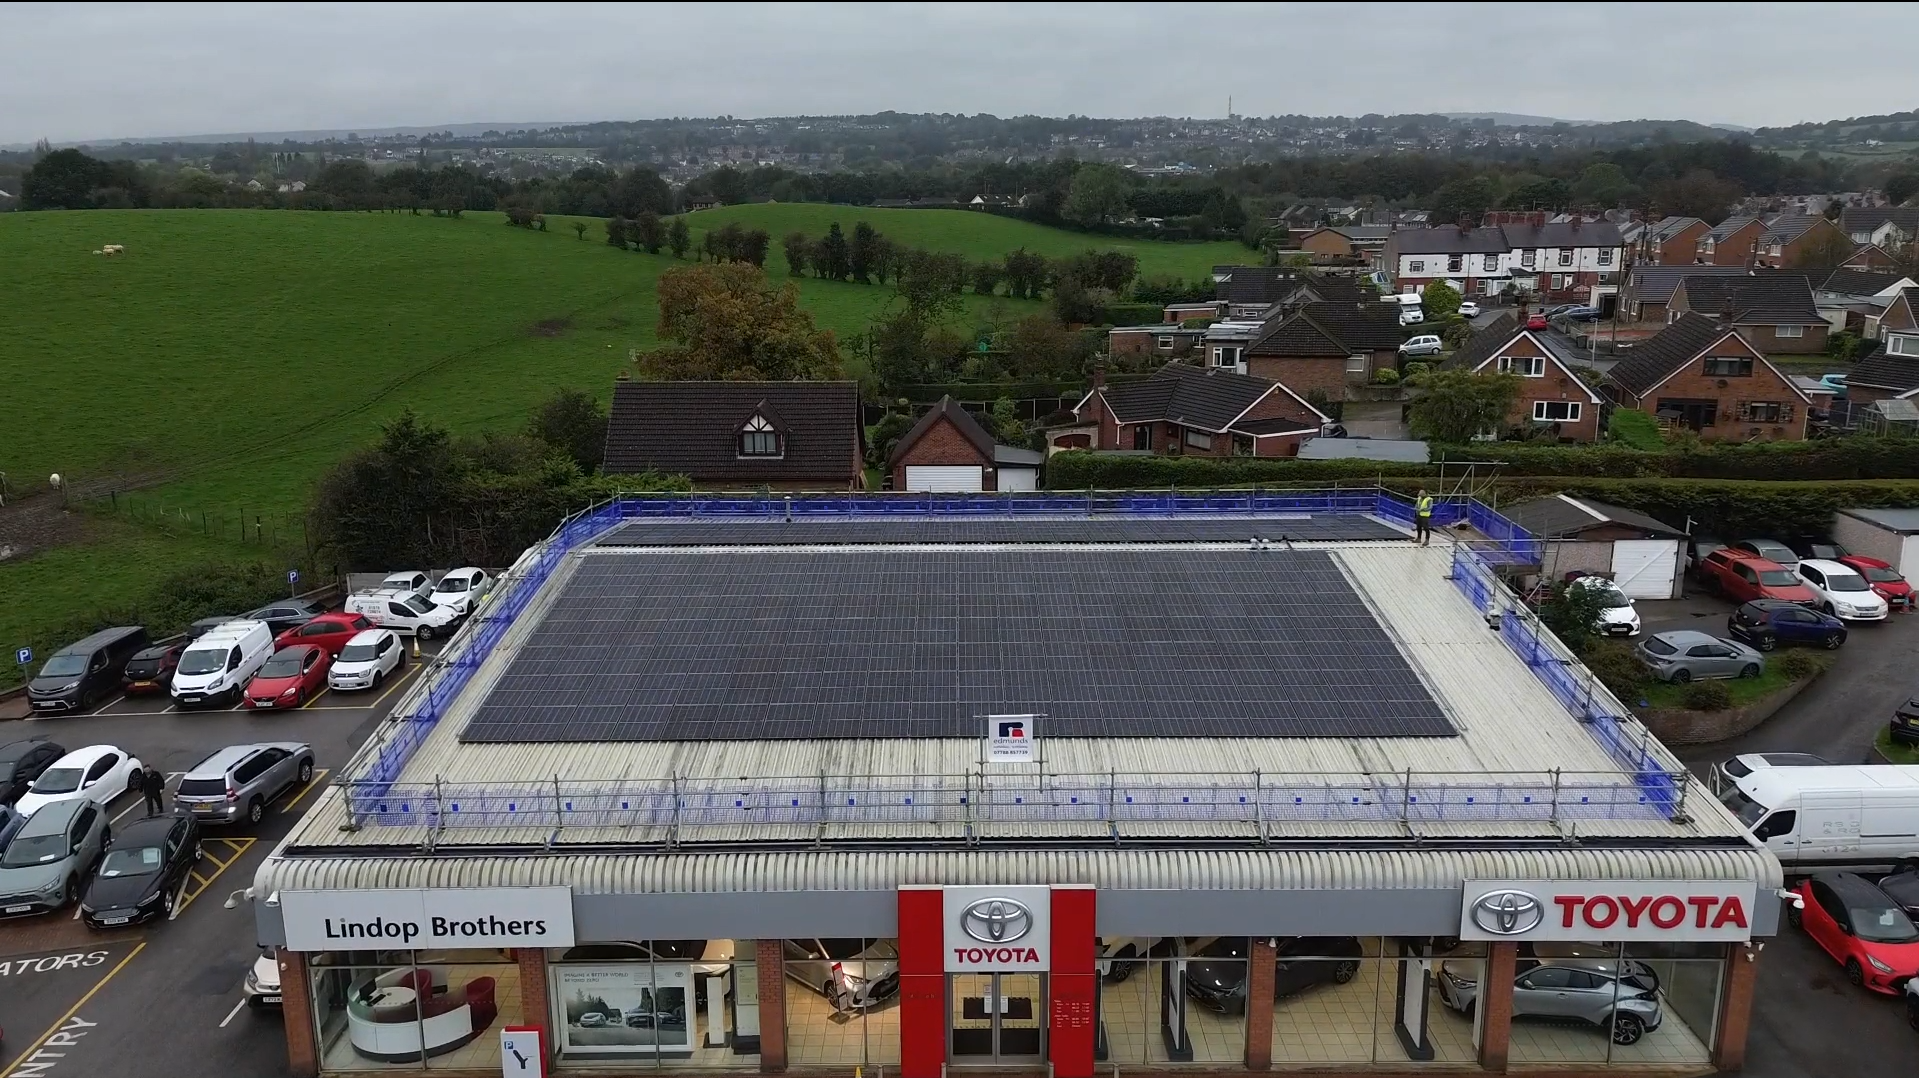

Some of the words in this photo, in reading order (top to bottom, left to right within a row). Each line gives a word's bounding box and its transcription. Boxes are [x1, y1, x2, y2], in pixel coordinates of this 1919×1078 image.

[1554, 895, 1748, 929] TOYOTA
[325, 917, 419, 943] Lindop
[432, 915, 547, 936] Brothers
[954, 947, 1040, 963] TOYOTA
